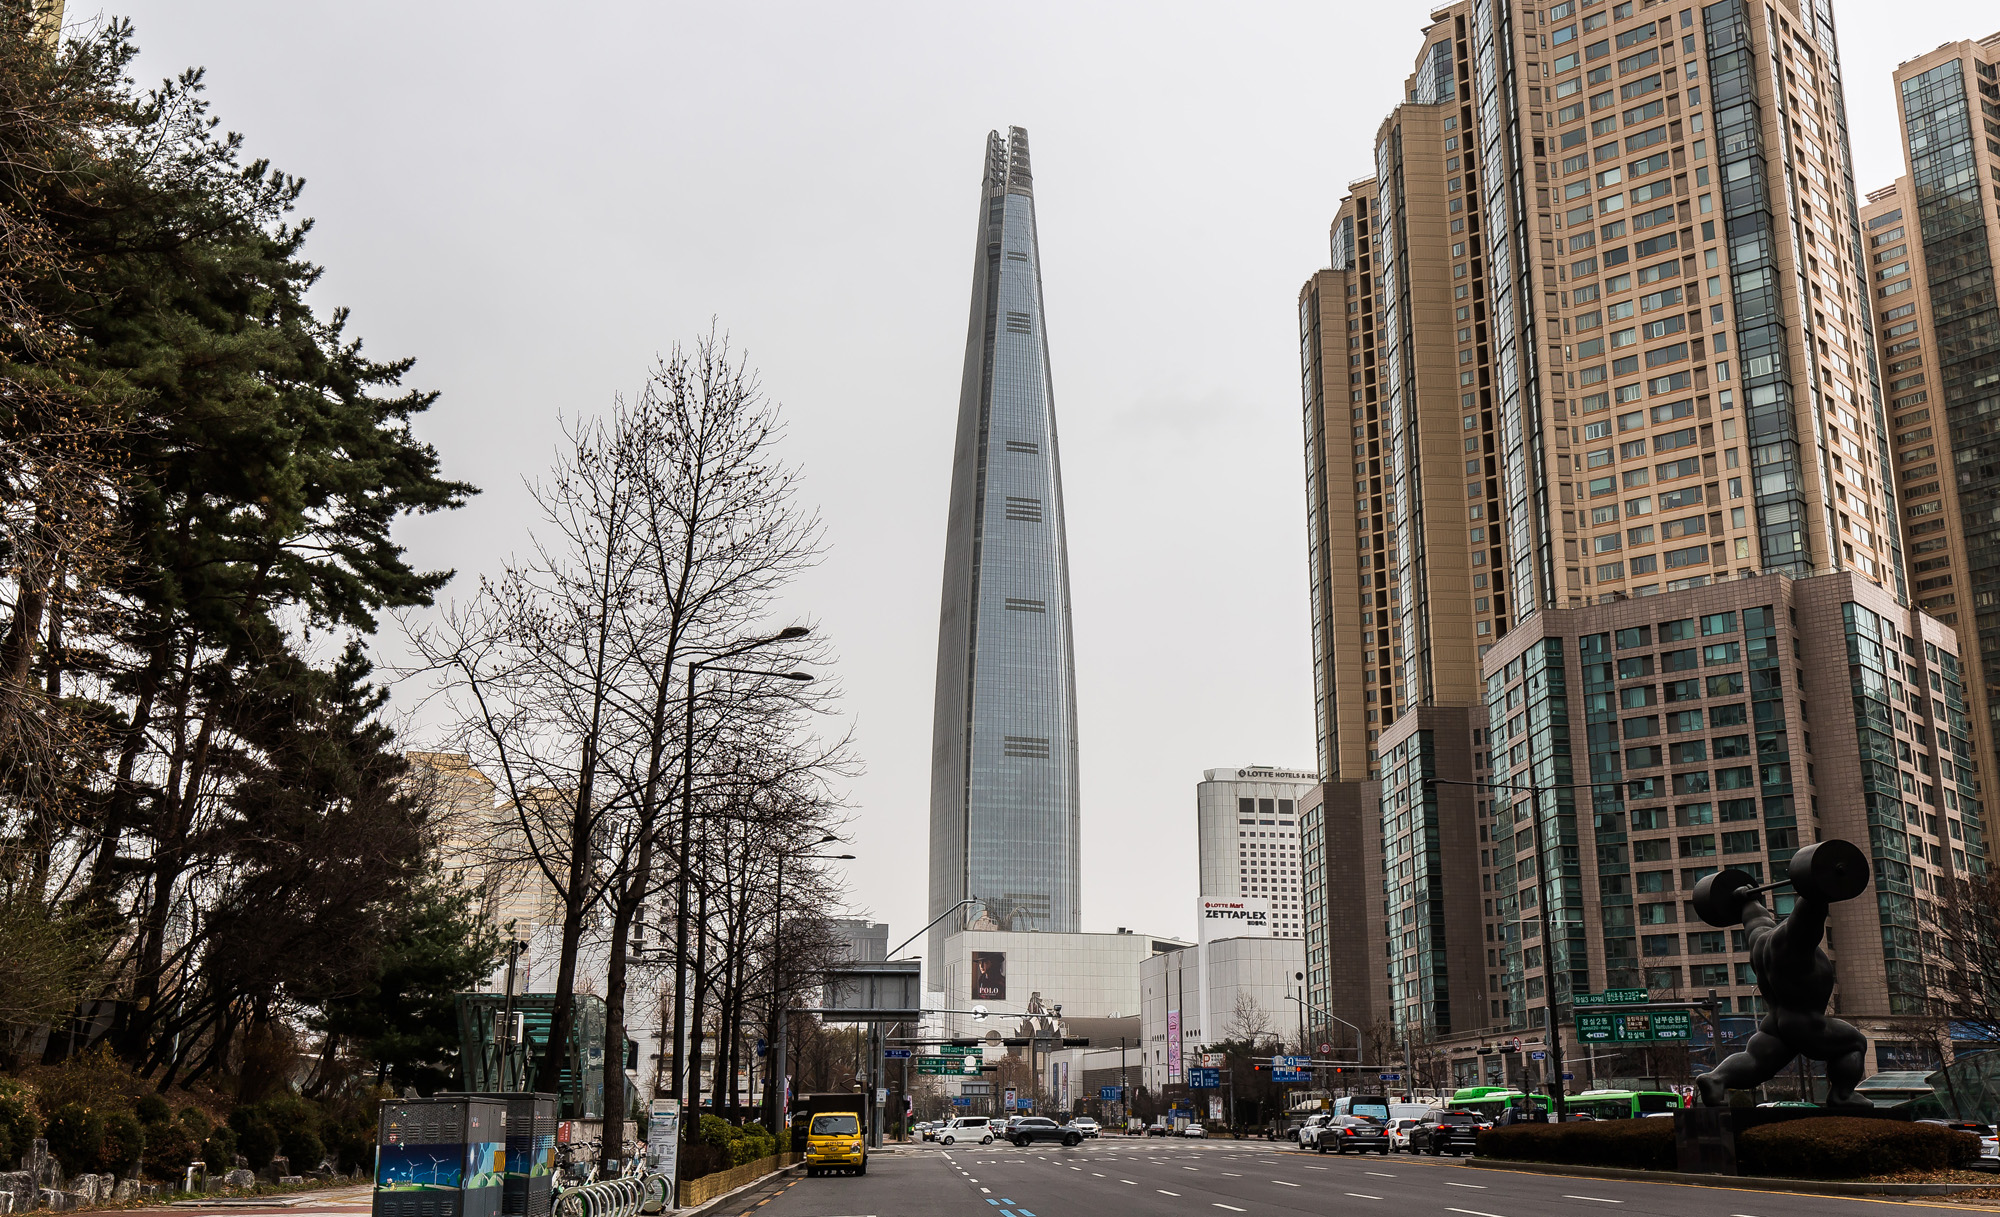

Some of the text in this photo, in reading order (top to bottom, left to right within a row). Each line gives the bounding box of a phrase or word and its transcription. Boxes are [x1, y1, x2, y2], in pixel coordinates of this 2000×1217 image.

[1205, 910, 1266, 919] ZETTAPLEX
[1582, 1017, 1608, 1026] 잠실2동
[1654, 1016, 1688, 1024] 남부순환로
[1203, 1054, 1210, 1067] P
